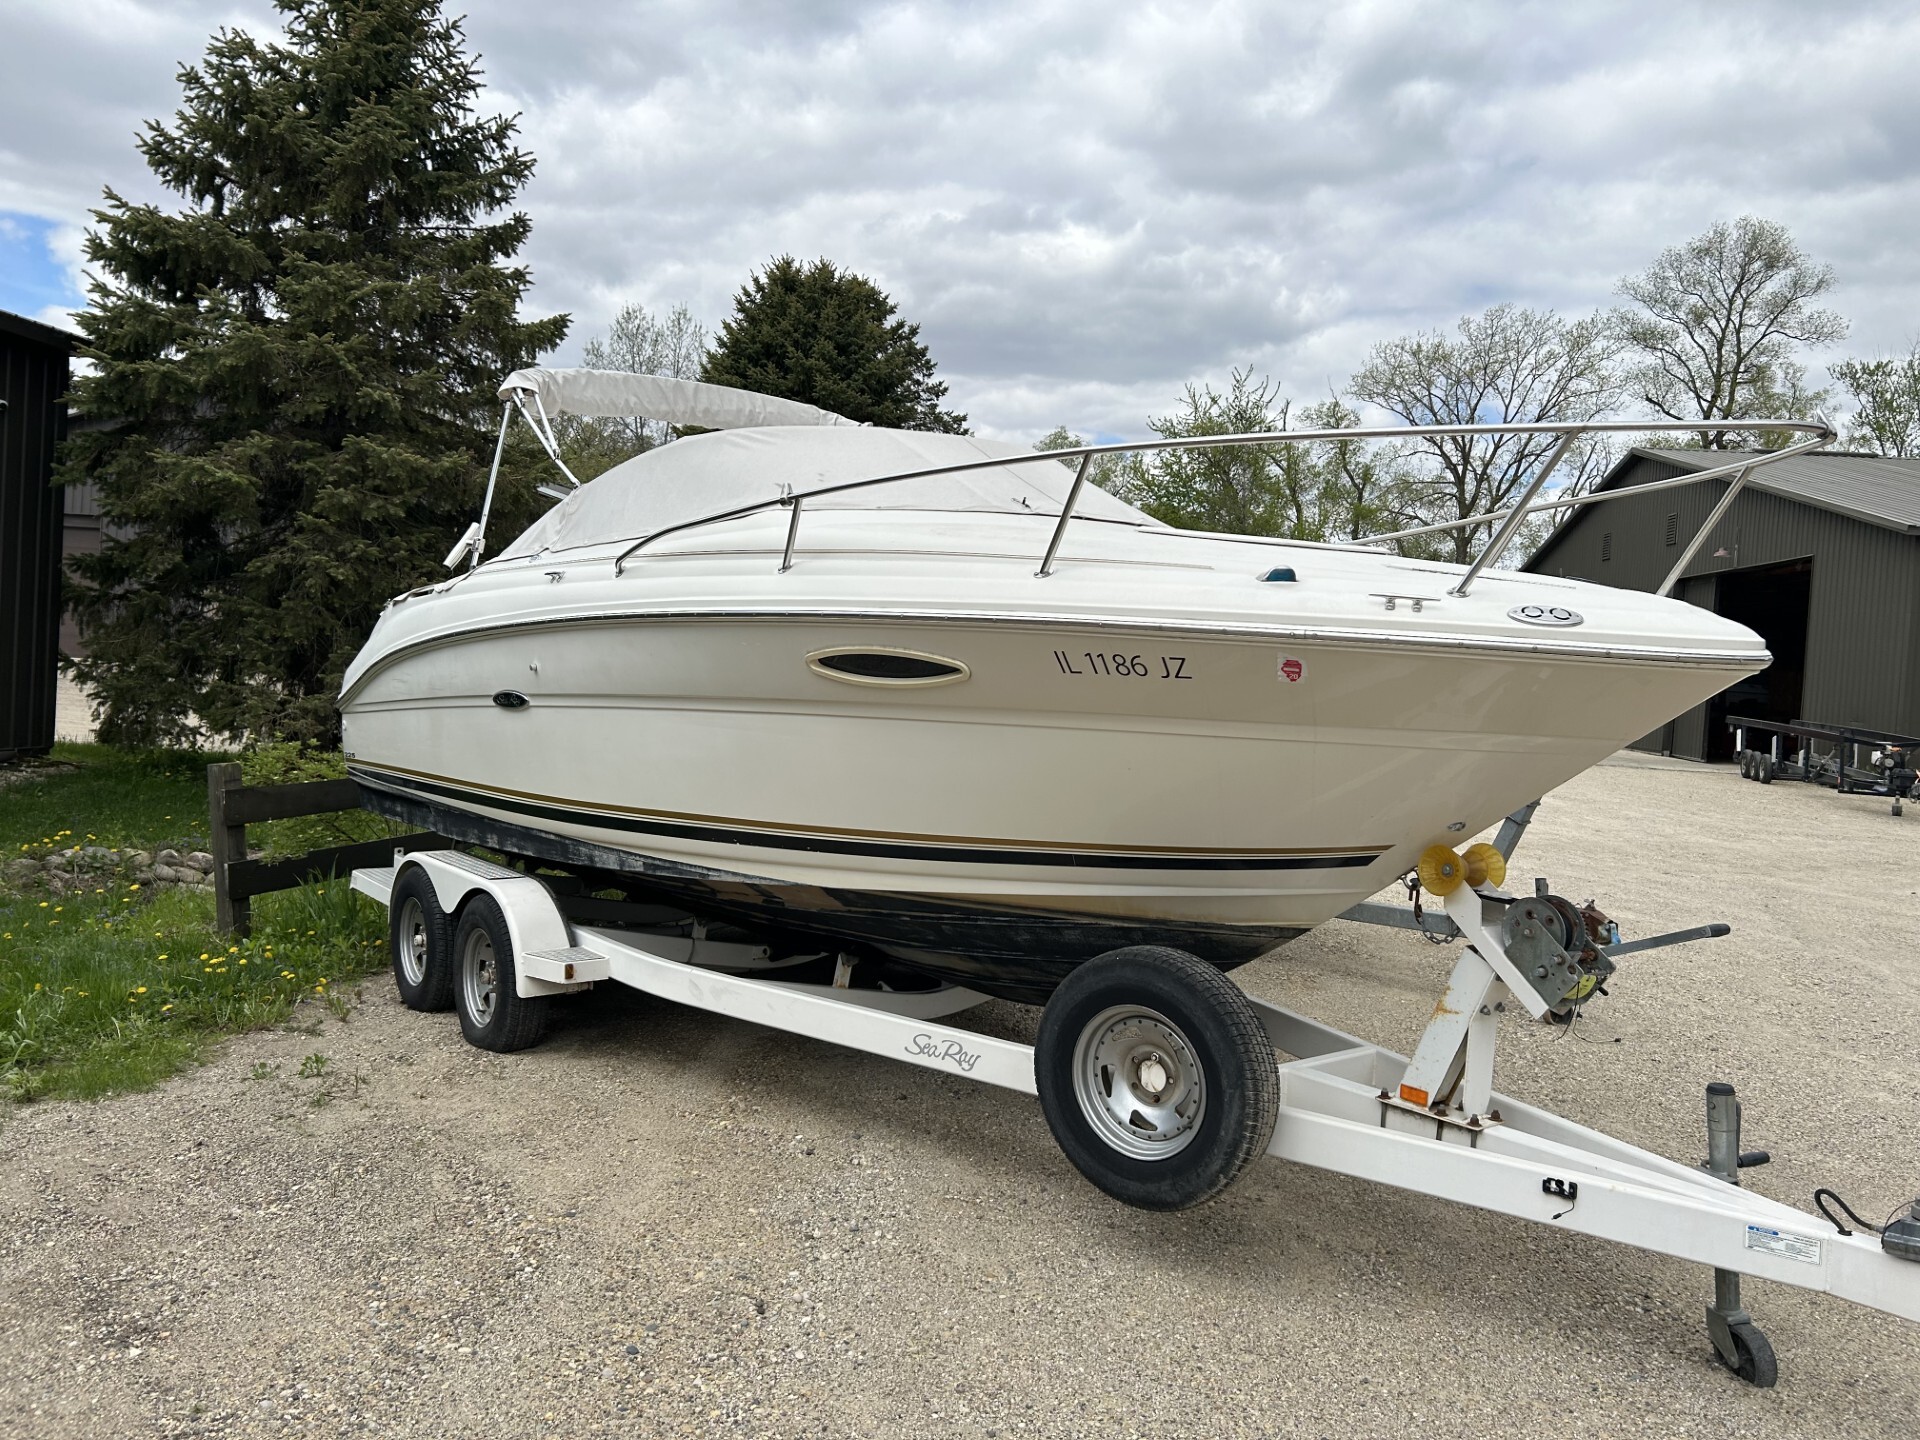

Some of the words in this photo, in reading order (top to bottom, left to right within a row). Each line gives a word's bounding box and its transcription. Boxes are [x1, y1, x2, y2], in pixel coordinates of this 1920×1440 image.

[1053, 650, 1082, 674] IL
[1084, 652, 1148, 677] 1186
[1161, 656, 1192, 679] JZ
[904, 1033, 942, 1058] Sea
[941, 1039, 982, 1072] Ray
